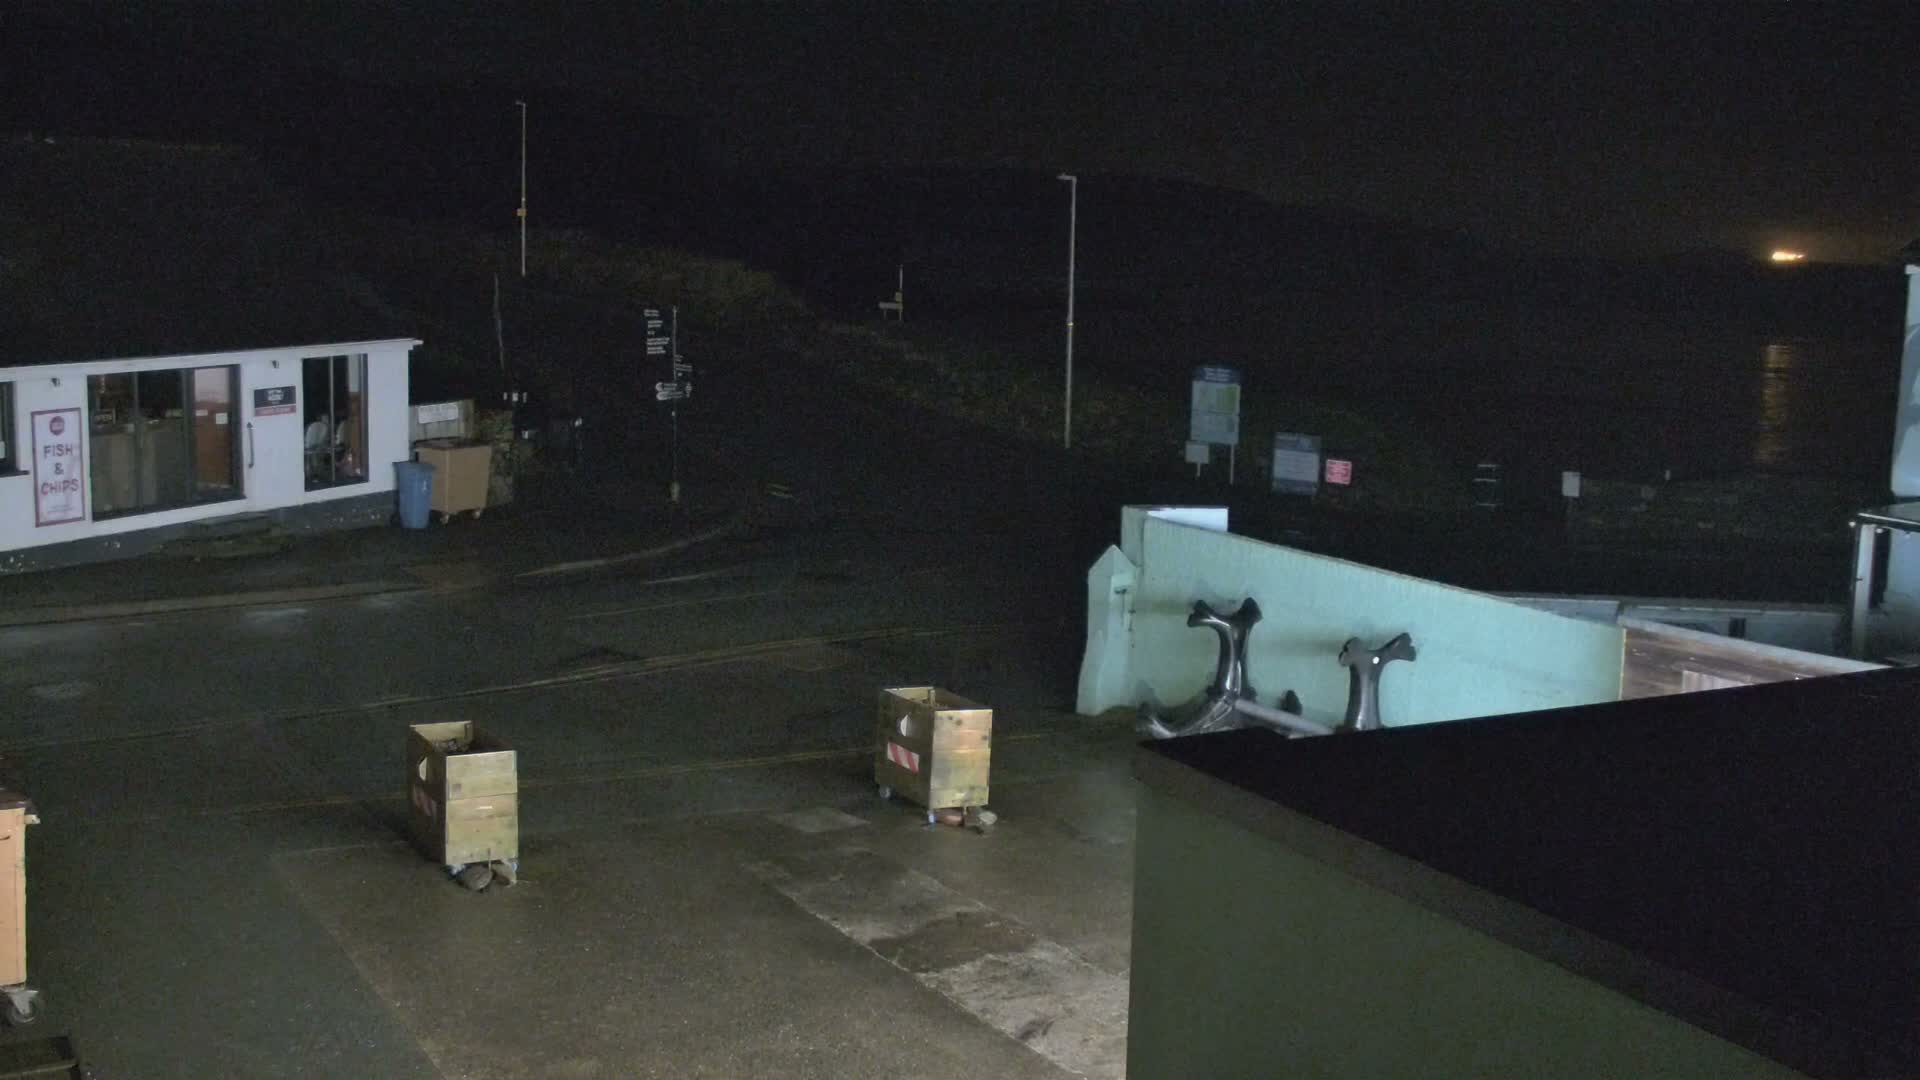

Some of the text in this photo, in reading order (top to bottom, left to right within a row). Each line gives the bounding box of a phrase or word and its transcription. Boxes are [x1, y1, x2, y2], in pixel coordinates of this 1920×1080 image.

[43, 443, 73, 458] FISH
[54, 462, 64, 475] &
[41, 478, 79, 496] CHIPS
